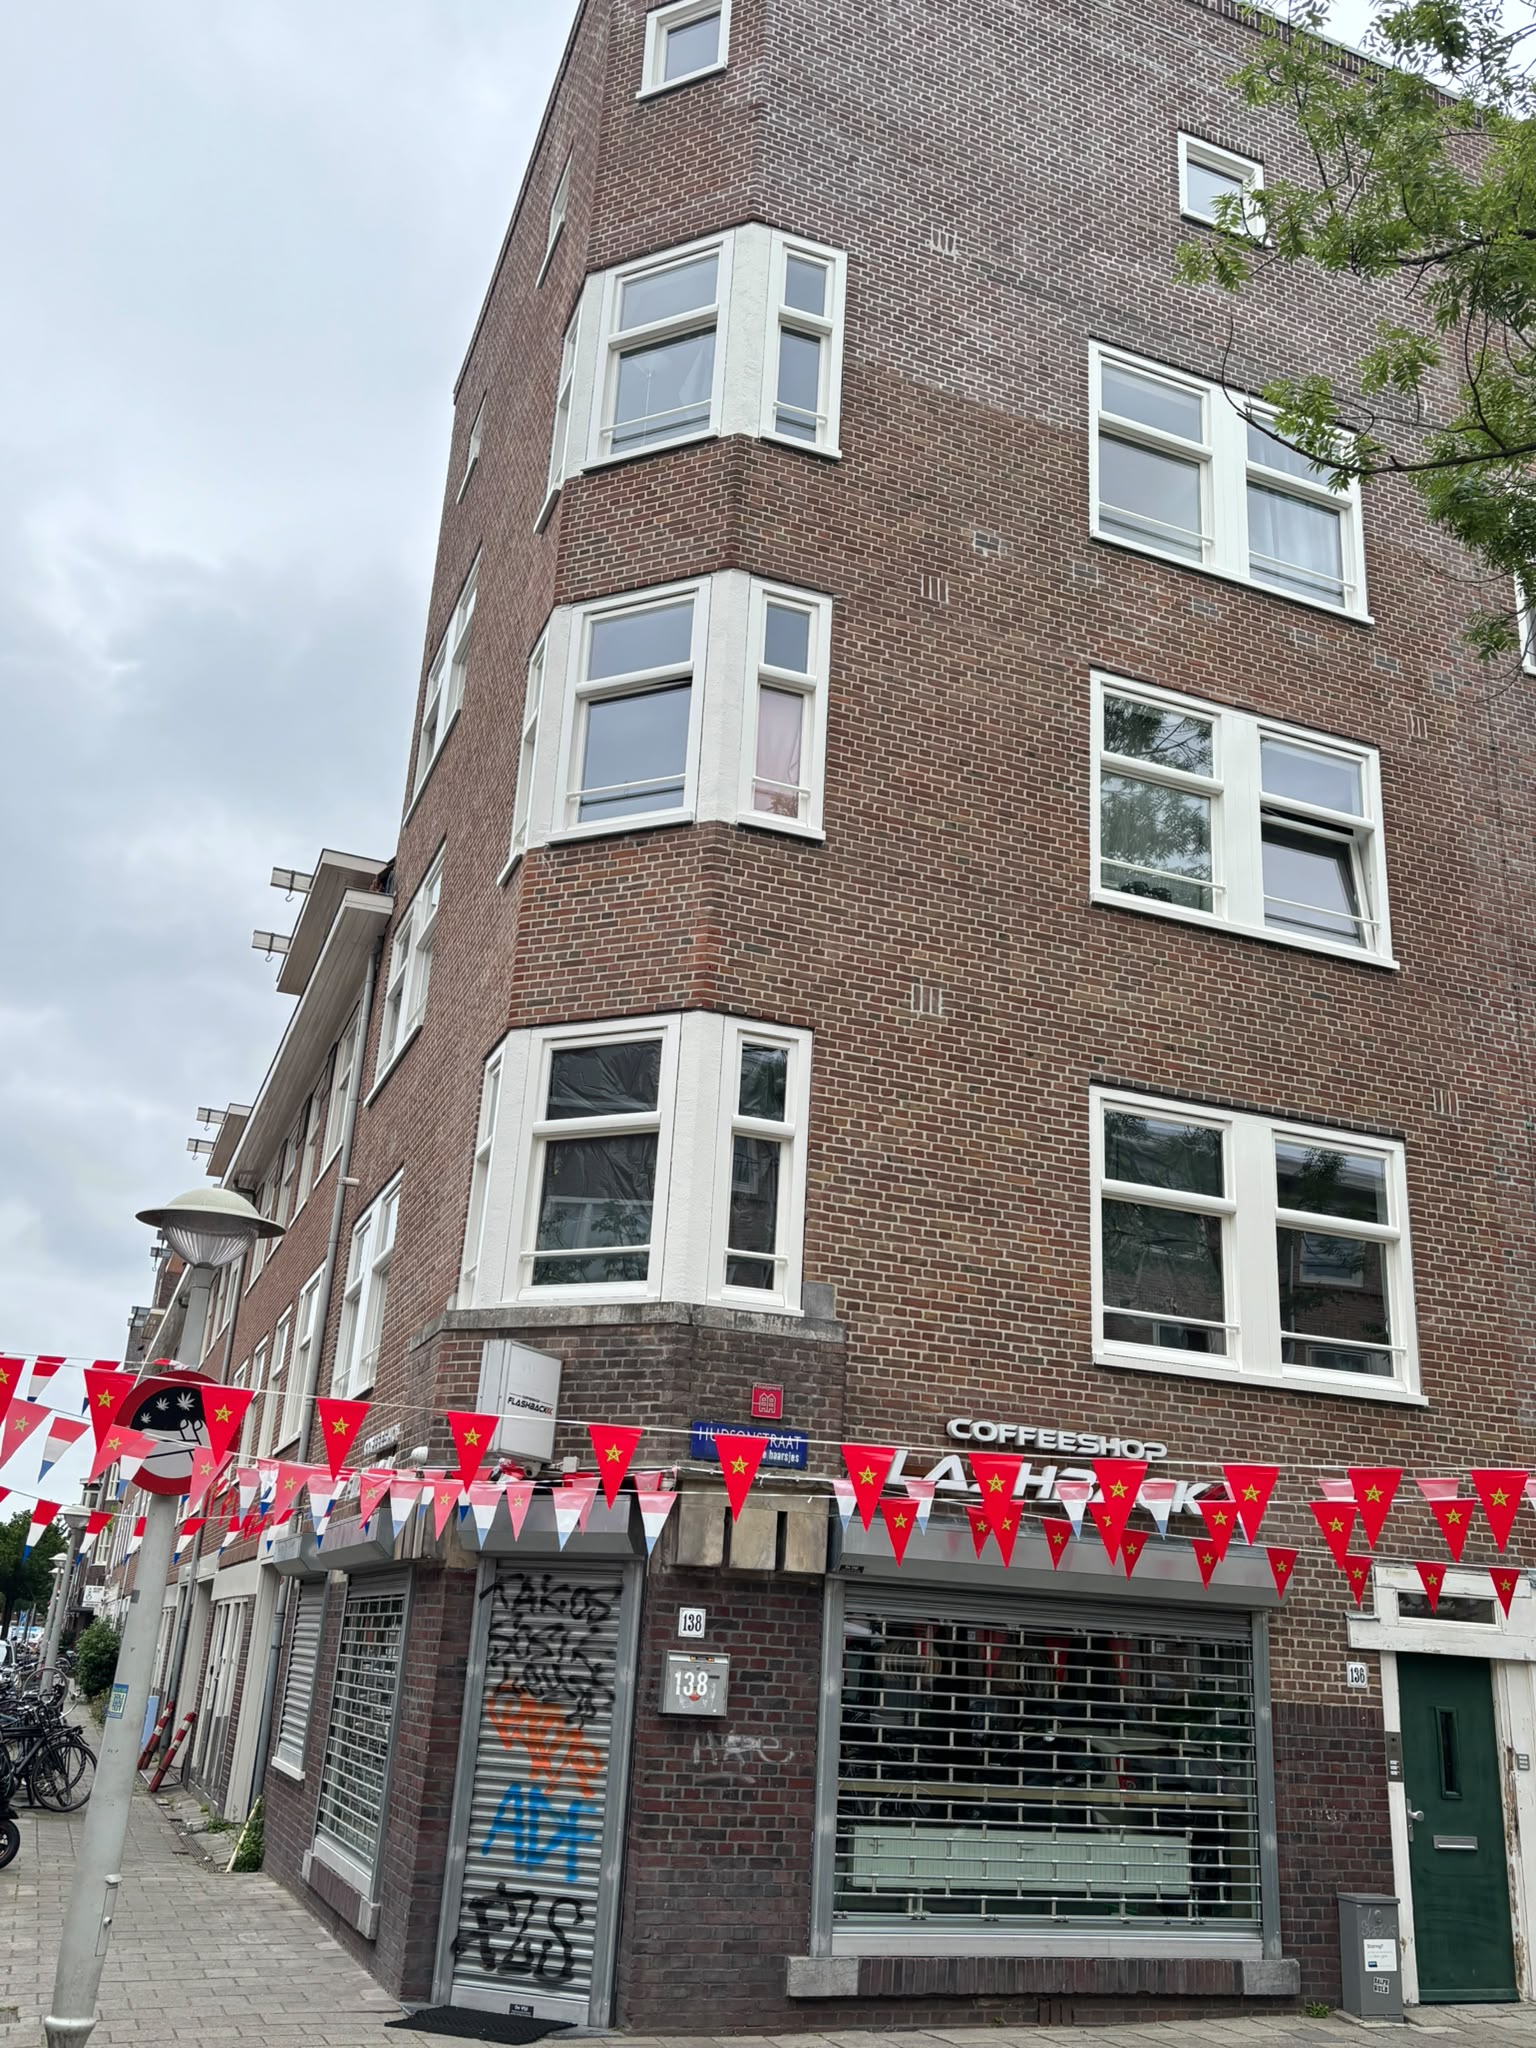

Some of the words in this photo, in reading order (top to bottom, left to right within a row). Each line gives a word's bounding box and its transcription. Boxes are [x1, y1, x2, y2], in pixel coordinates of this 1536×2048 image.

[699, 1426, 802, 1450] HURAAT
[946, 1418, 1167, 1460] COFFEESHOP
[886, 1450, 1212, 1515] LAHBCK
[682, 1613, 702, 1632] 138
[674, 1671, 709, 1696] 138
[1350, 1666, 1366, 1684] 136
